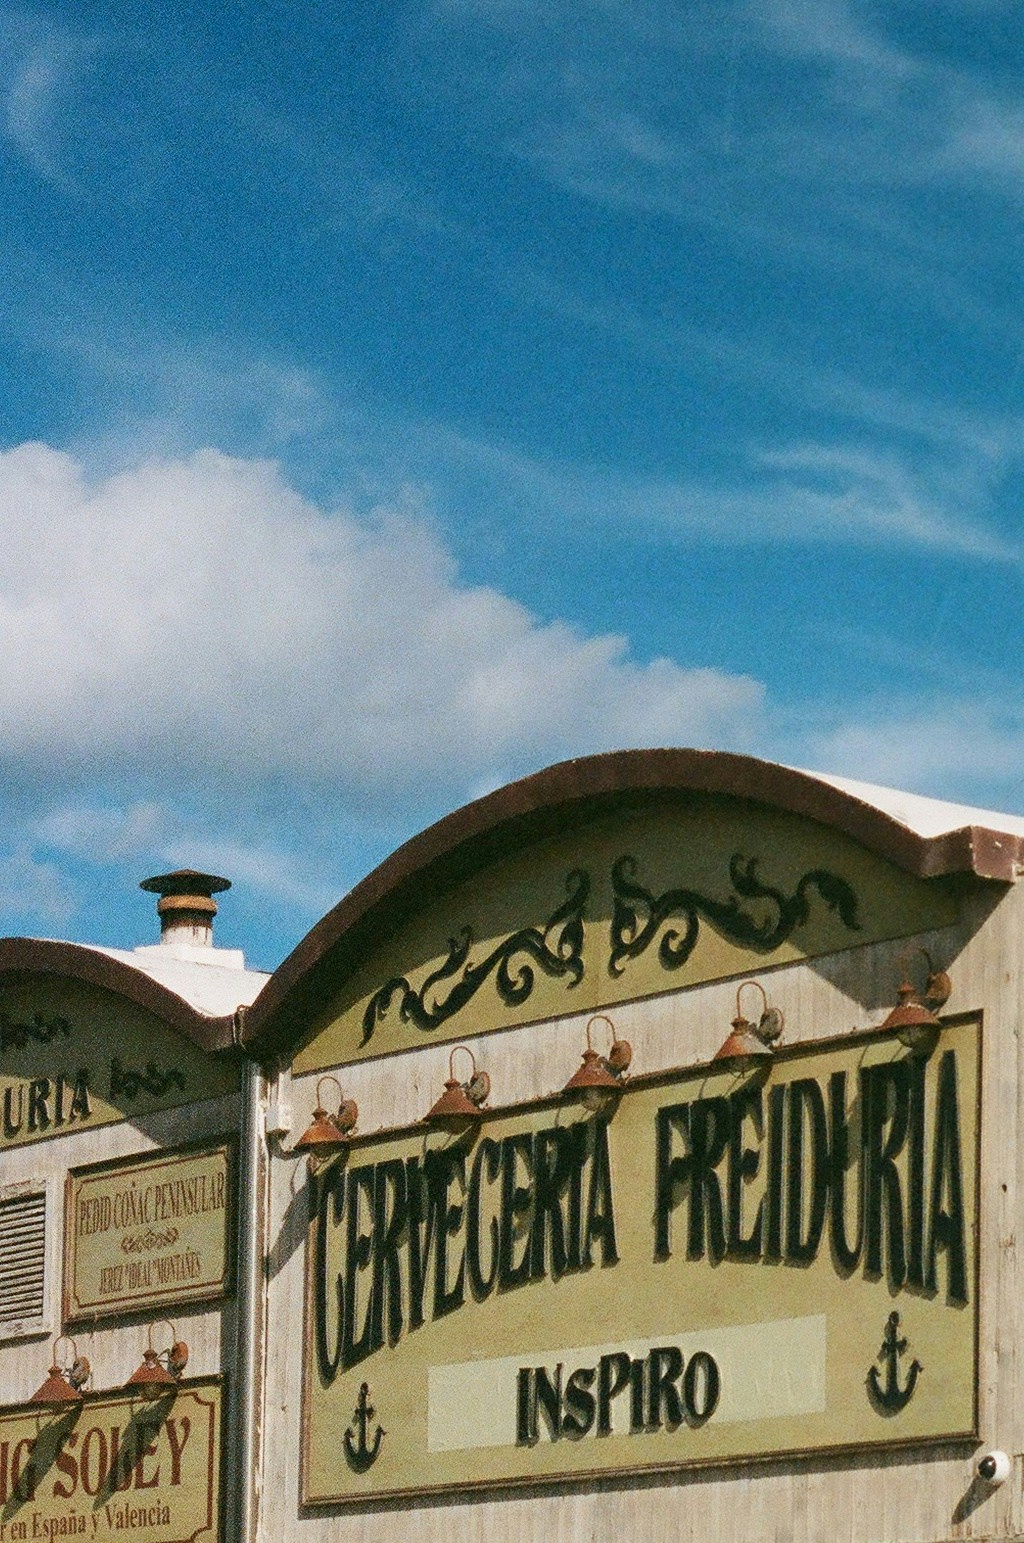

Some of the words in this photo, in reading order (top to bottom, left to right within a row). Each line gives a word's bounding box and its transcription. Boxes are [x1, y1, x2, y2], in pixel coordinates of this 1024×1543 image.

[79, 1195, 111, 1236] PEDID
[155, 1171, 225, 1222] PENINSULAR
[314, 1120, 620, 1390] CERVECERIA
[653, 1049, 969, 1311] FREIDURIA
[515, 1345, 721, 1448] INSPIRO
[53, 1416, 191, 1499] SOLEY
[11, 1522, 27, 1540] en
[32, 1509, 87, 1543] España
[91, 1513, 98, 1540] y
[105, 1500, 170, 1530] Valencia
